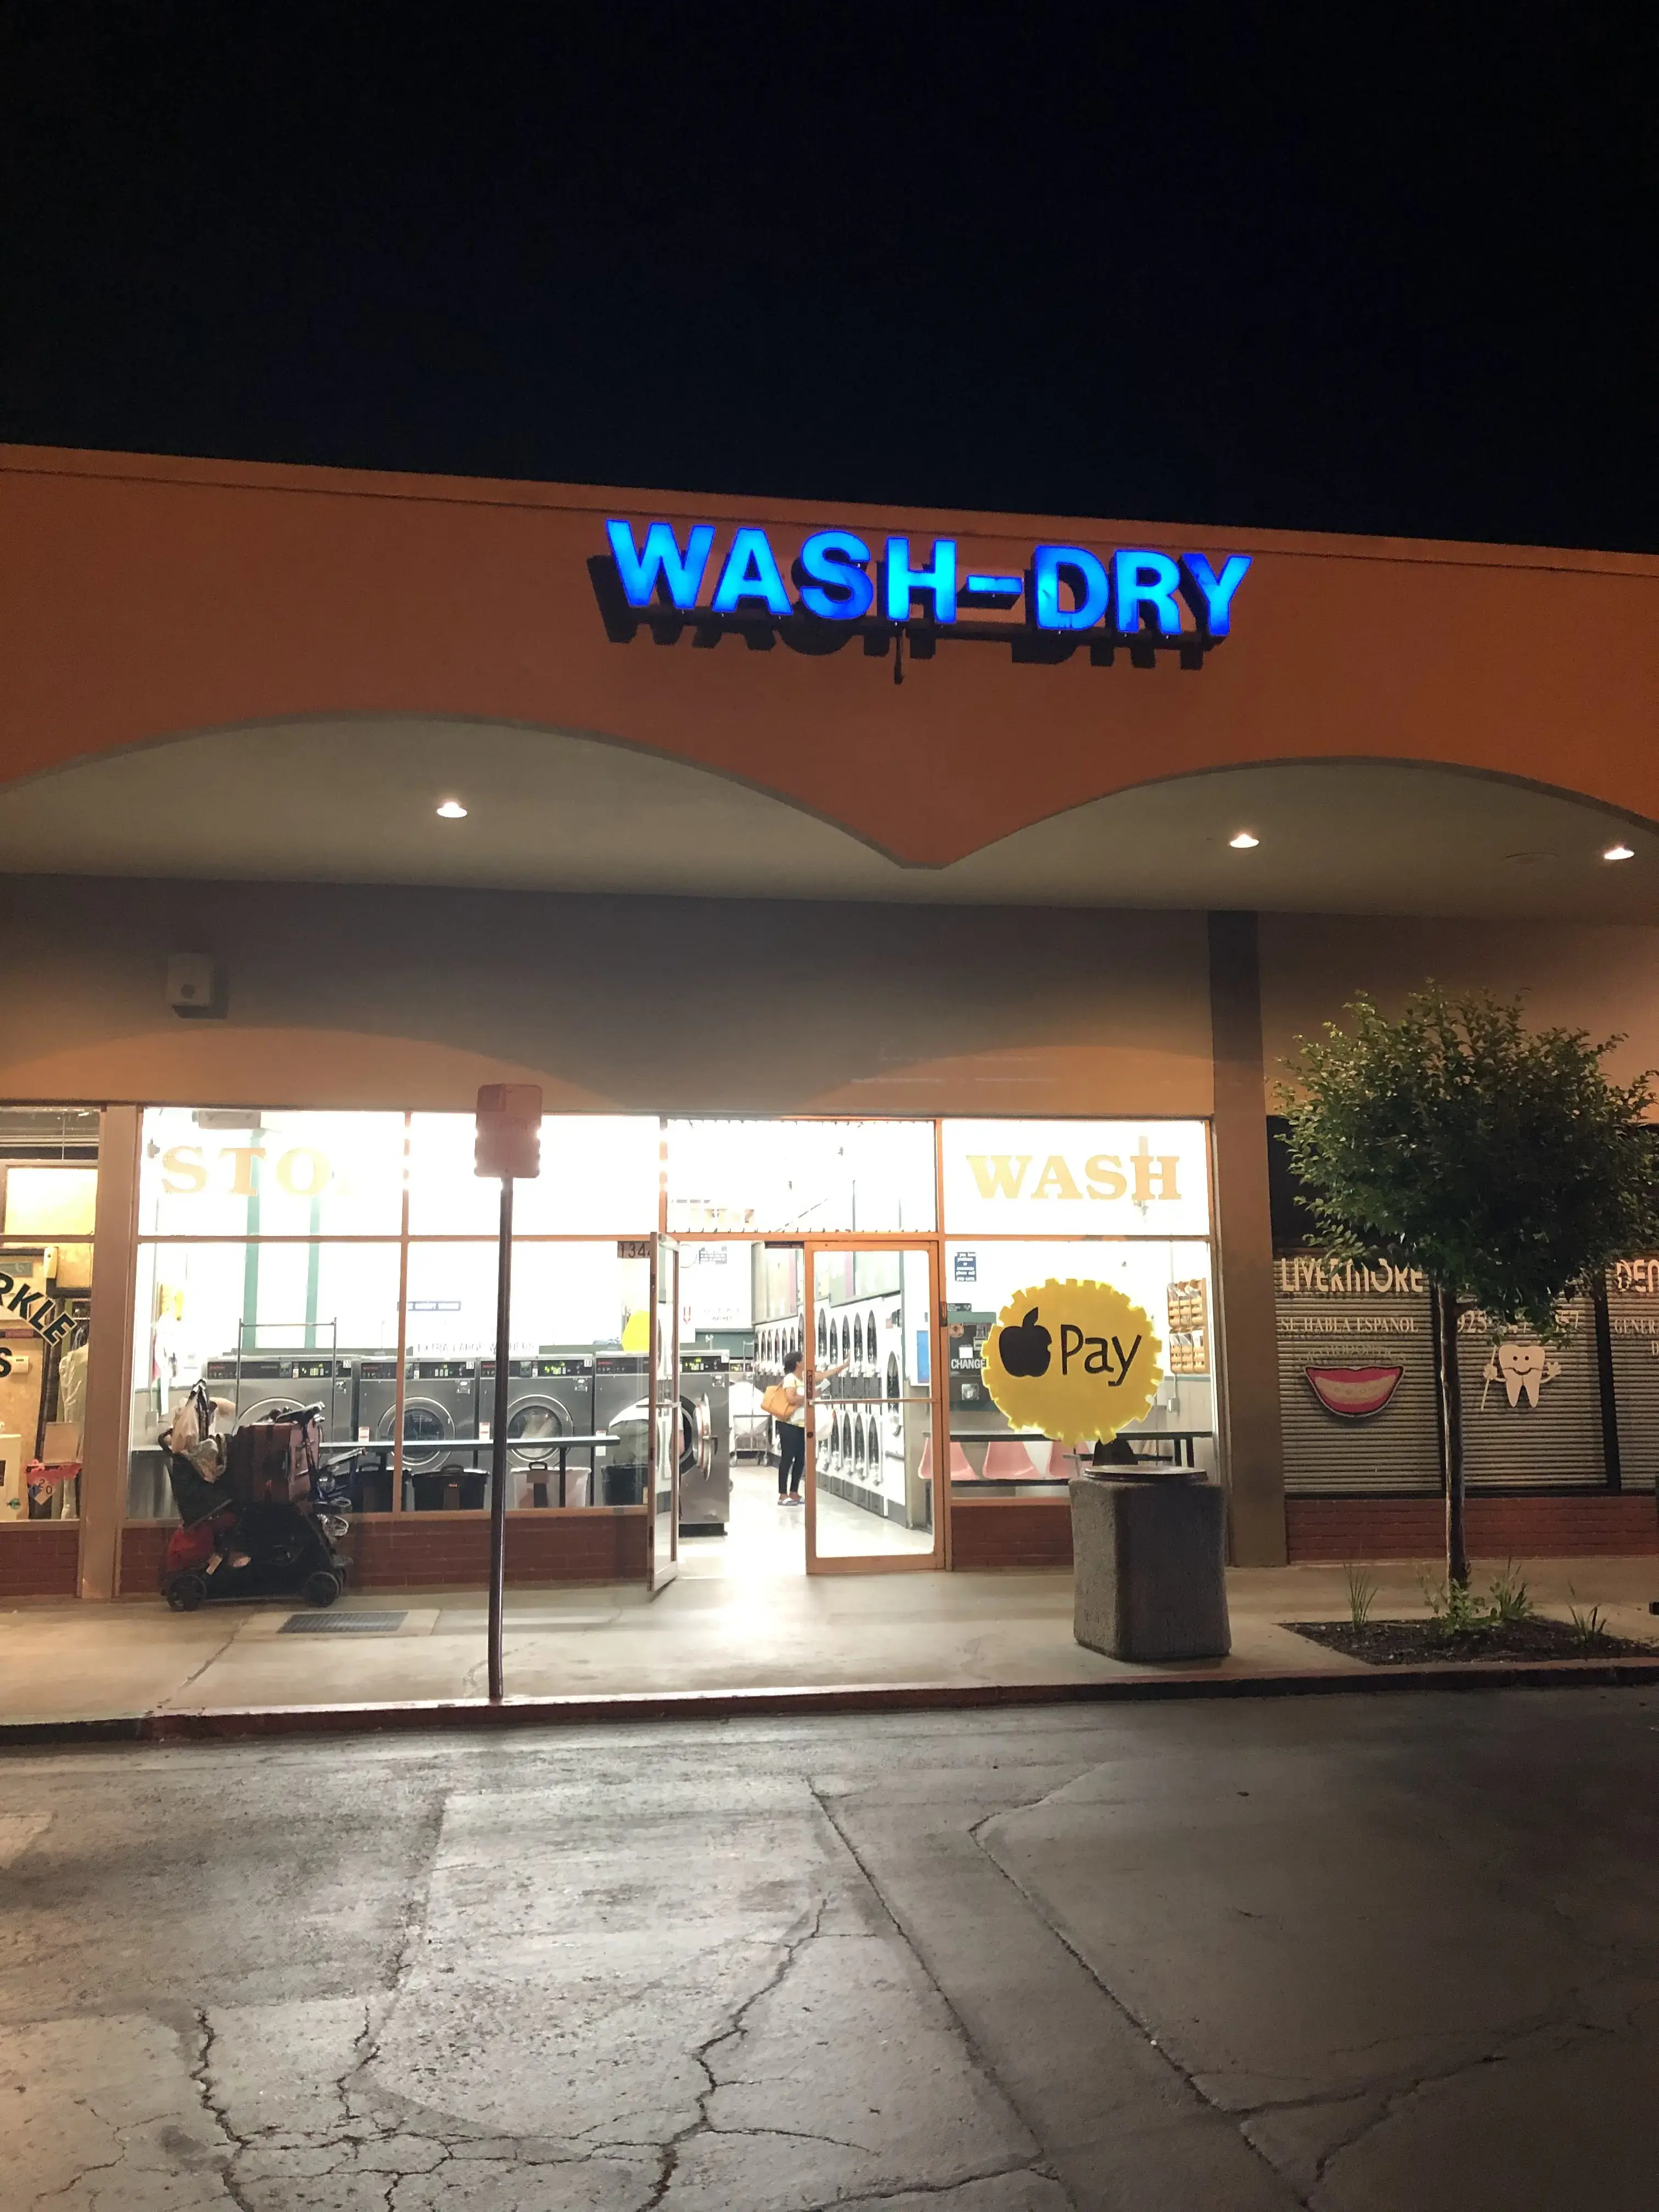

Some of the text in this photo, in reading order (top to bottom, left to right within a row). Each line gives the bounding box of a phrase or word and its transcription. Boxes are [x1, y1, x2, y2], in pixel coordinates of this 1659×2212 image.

[606, 518, 1253, 636] WASH-DRY
[966, 1154, 1181, 1200] WASH
[620, 1241, 651, 1258] 134
[1282, 1258, 1423, 1293] LIVERMORE
[1304, 1317, 1351, 1332] HABLA
[951, 1359, 986, 1369] CHANGE
[1060, 1324, 1142, 1387] Pay
